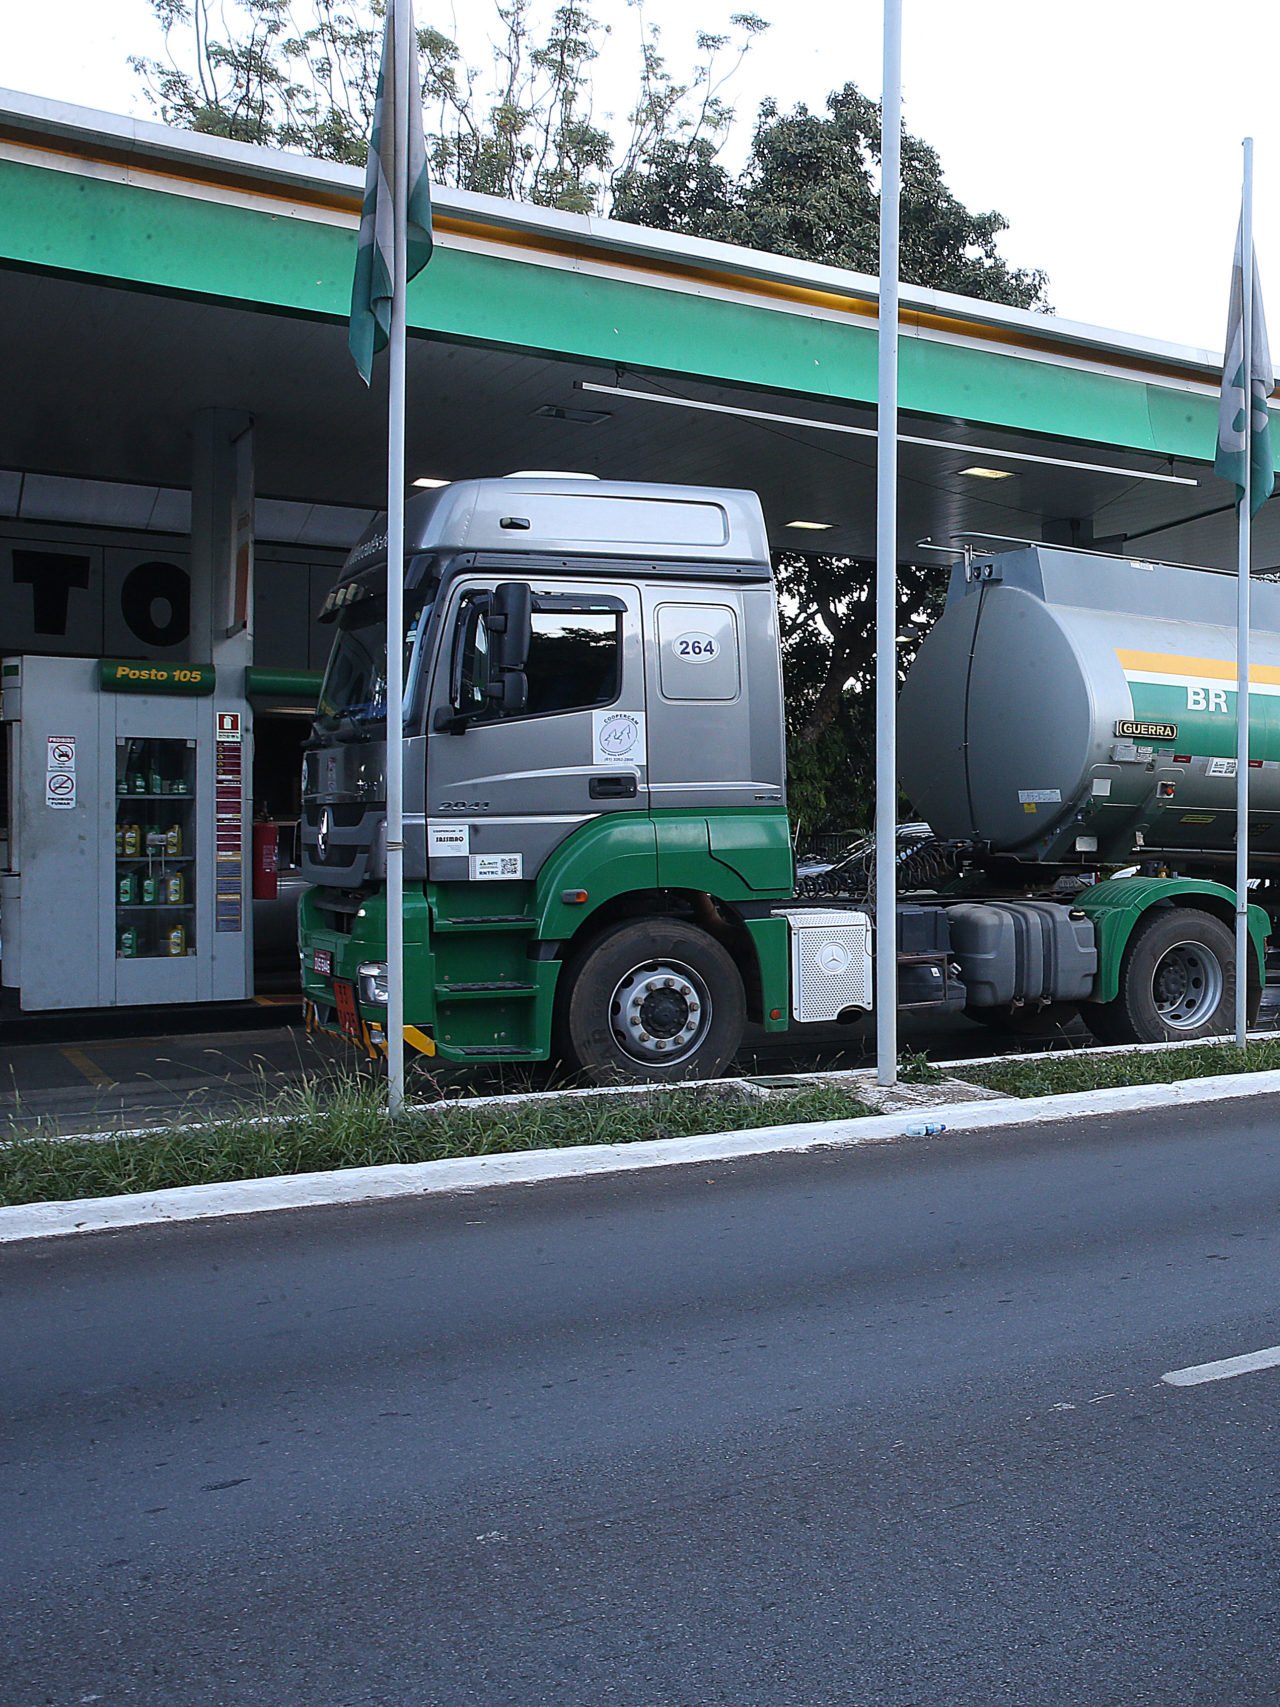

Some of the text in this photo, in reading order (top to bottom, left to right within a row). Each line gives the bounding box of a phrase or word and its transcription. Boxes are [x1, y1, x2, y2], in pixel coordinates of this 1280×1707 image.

[679, 640, 715, 655] 264
[115, 666, 202, 683] Posto 105
[1187, 686, 1228, 713] BR
[603, 714, 639, 725] COOPERCAM
[1123, 723, 1173, 736] GUERRA
[438, 800, 491, 811] 2041
